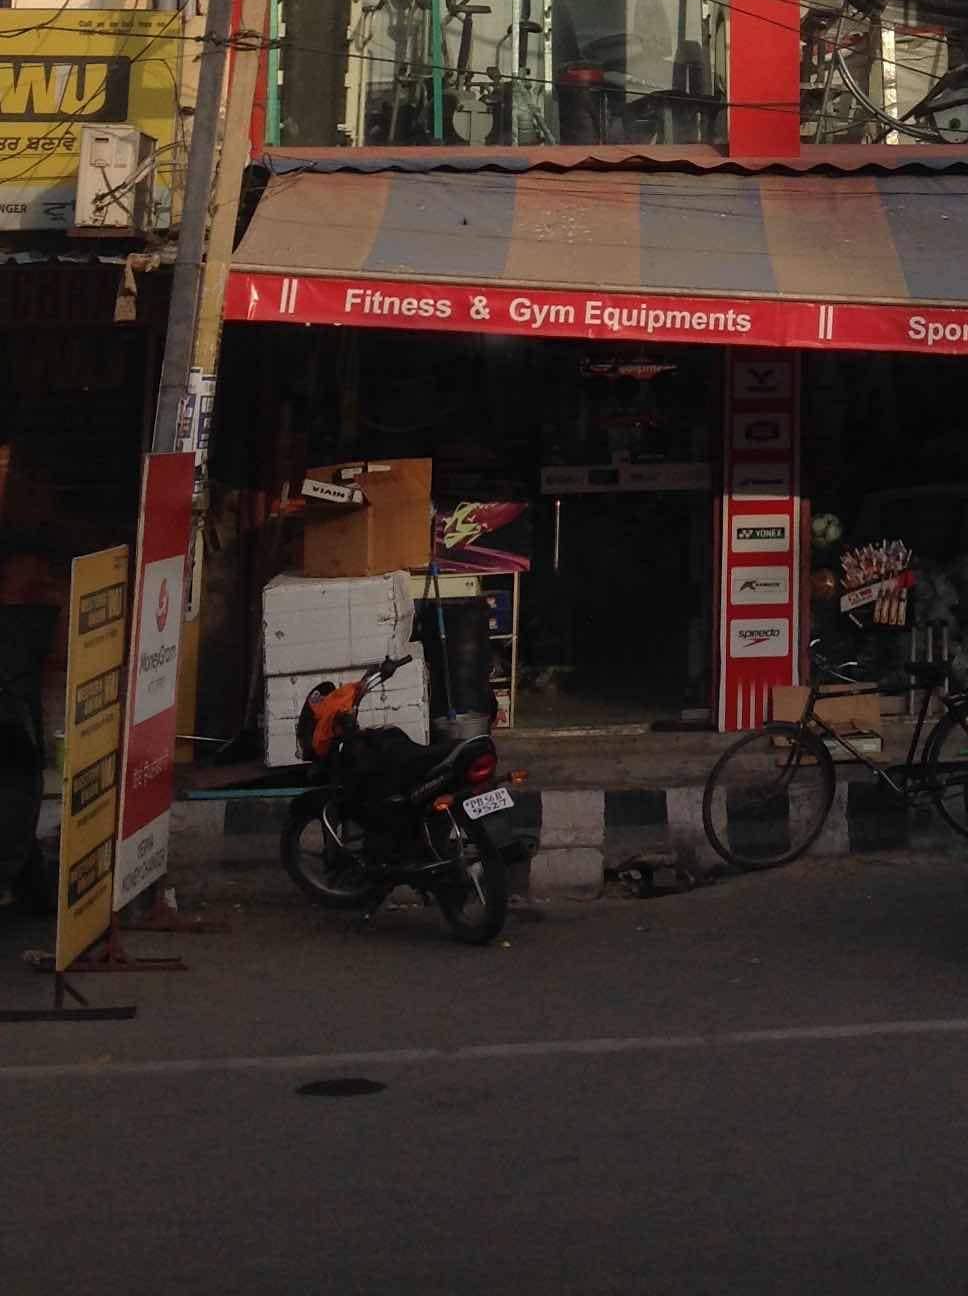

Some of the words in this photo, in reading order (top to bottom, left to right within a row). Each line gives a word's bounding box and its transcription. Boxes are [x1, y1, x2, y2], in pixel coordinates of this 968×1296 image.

[345, 288, 452, 318] Fitness
[469, 296, 491, 320] &
[509, 297, 576, 329] Gym
[584, 301, 751, 333] Equipments
